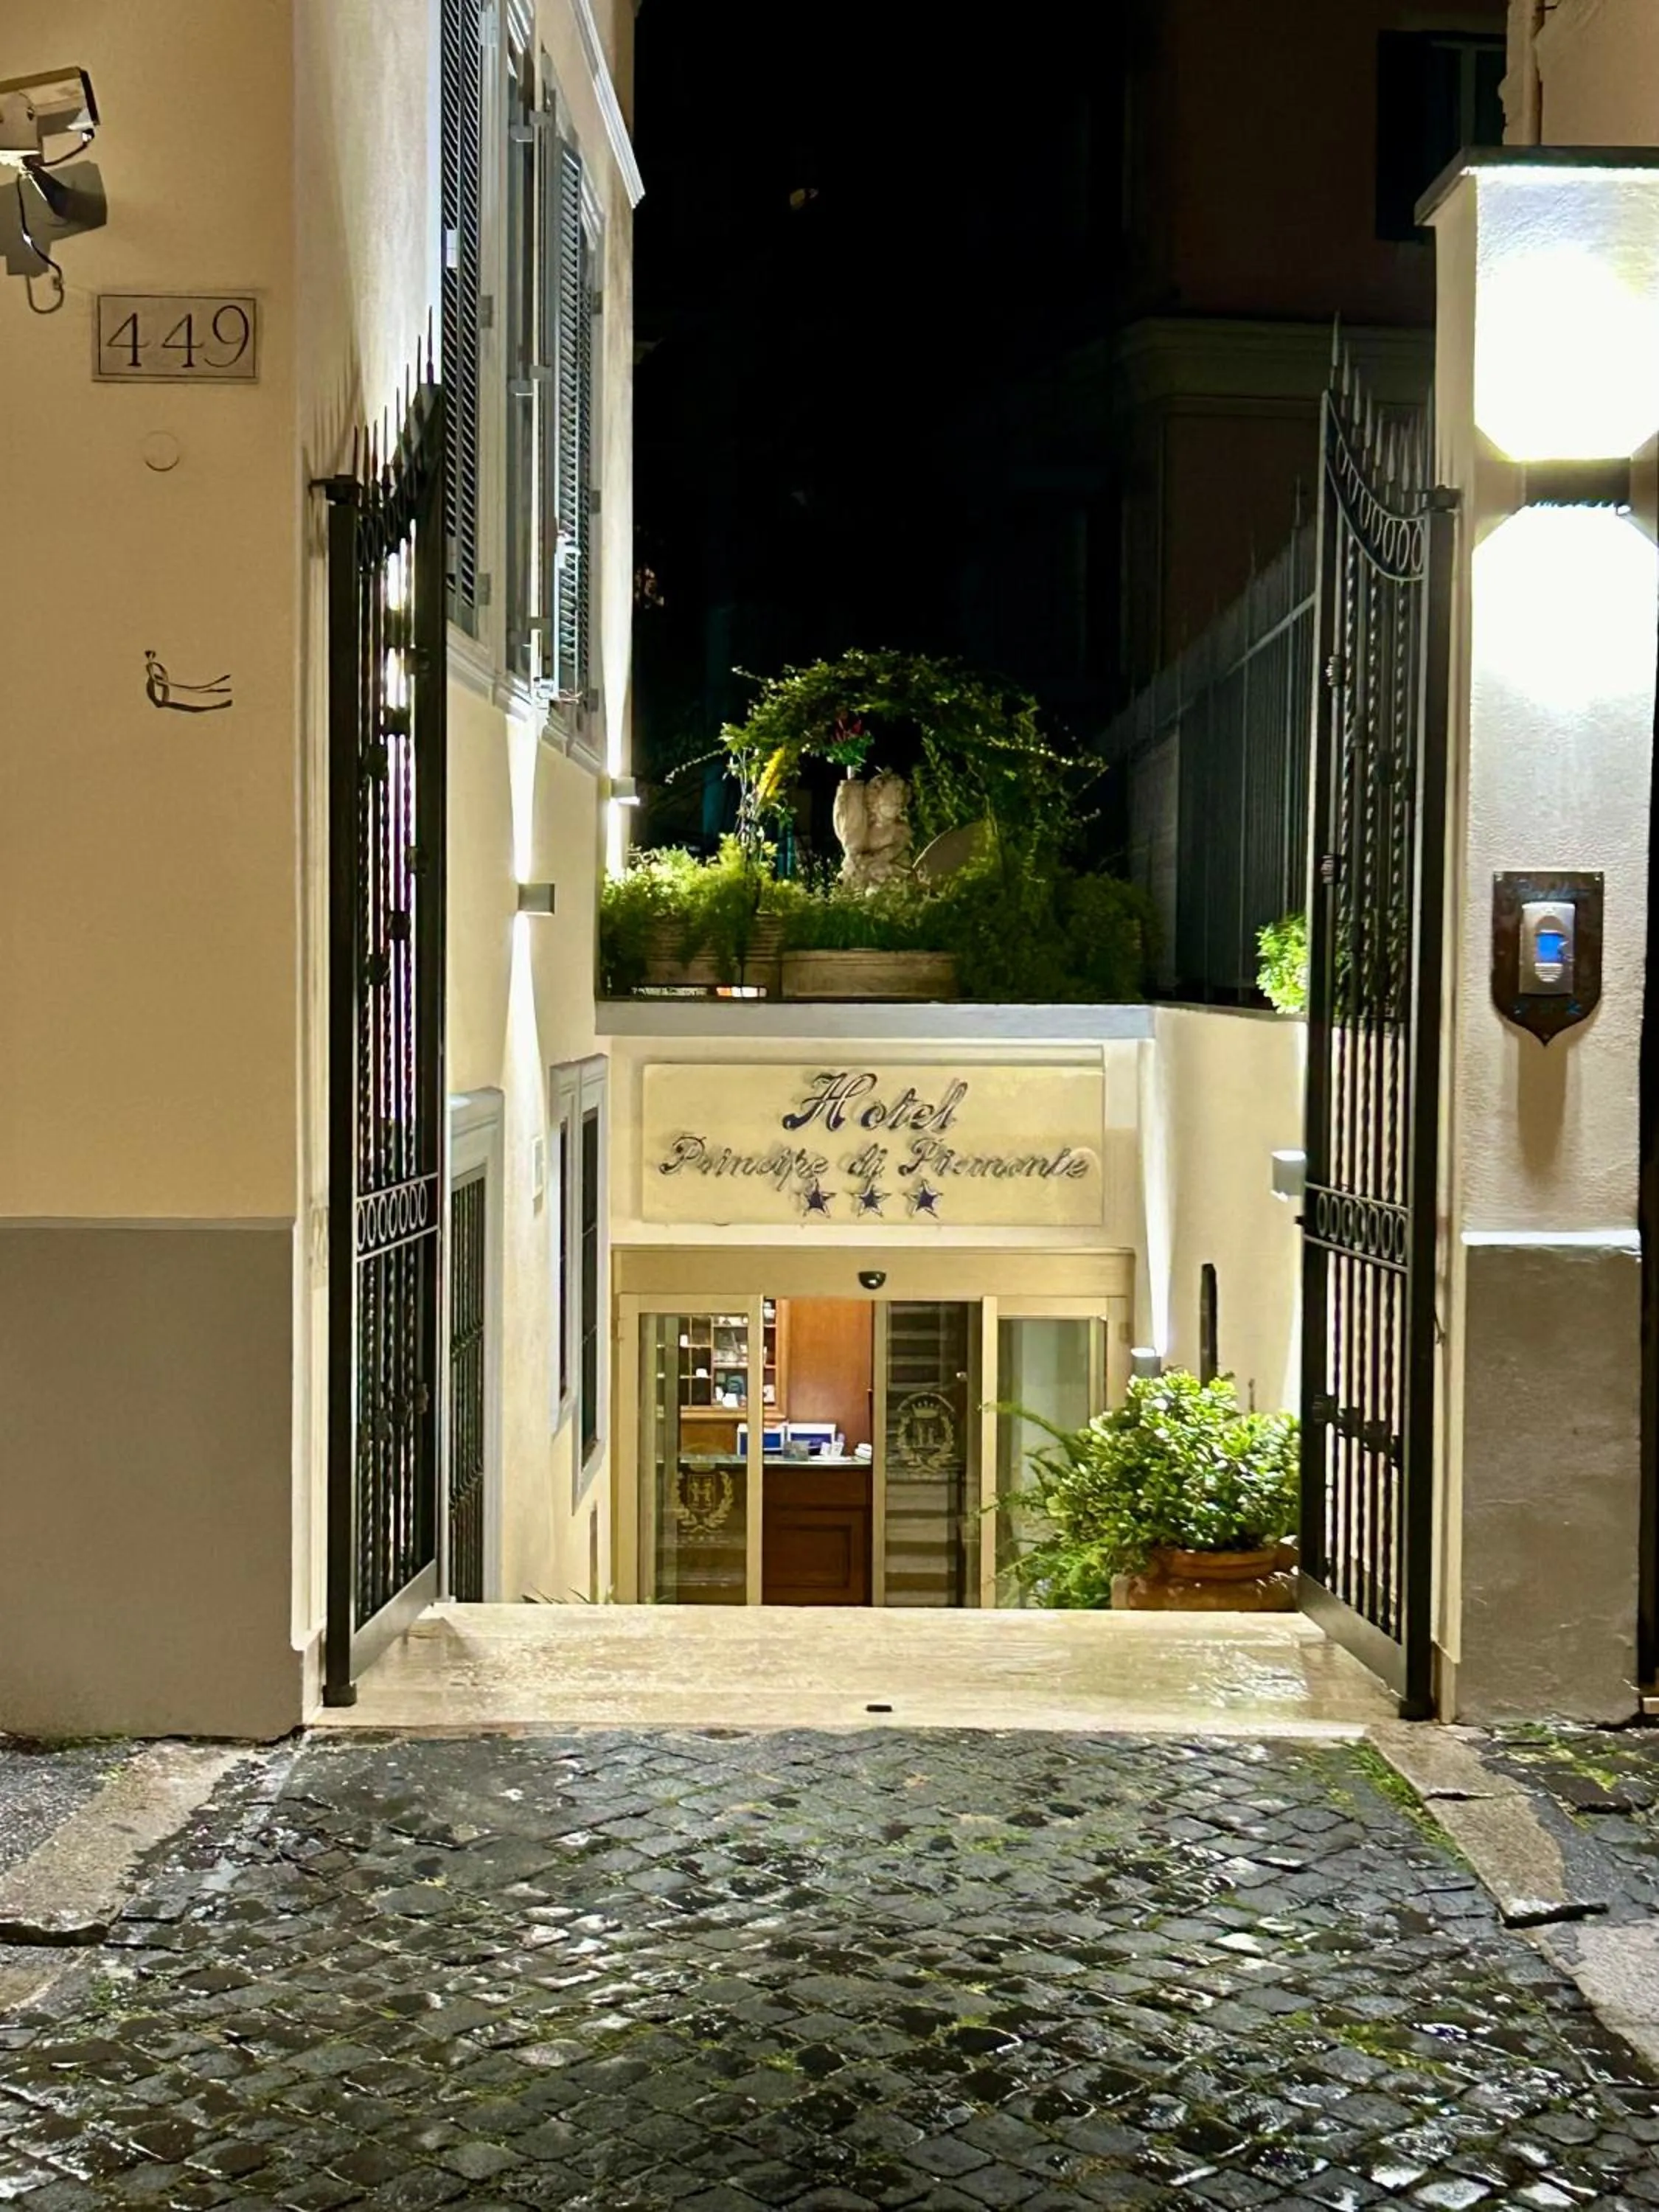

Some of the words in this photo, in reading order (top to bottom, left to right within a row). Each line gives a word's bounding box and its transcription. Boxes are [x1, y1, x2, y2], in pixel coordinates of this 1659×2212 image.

[106, 305, 250, 368] 449
[782, 1072, 968, 1132] Hotel
[659, 1135, 829, 1192] Principe
[847, 1142, 888, 1180] di
[897, 1137, 1089, 1178] Piemonte
